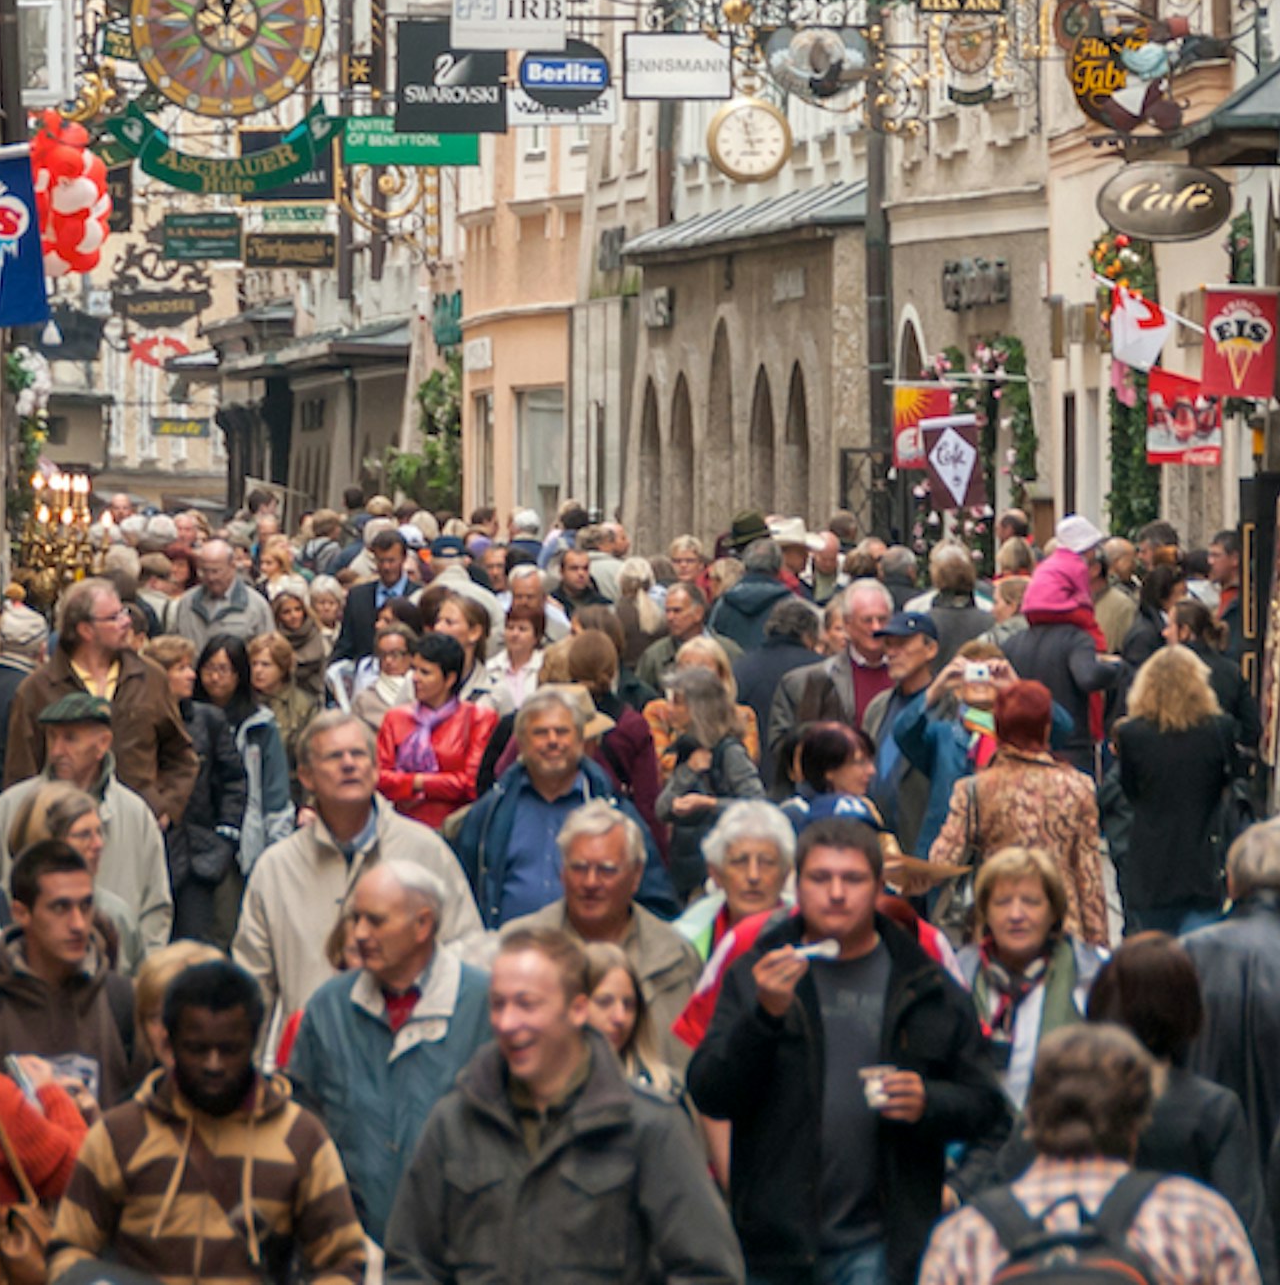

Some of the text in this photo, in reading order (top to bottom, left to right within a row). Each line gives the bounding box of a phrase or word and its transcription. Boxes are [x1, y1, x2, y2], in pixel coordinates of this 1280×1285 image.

[526, 59, 603, 84] Berlitz
[404, 85, 499, 105] SWAROVSKI
[1213, 319, 1268, 343] EIS
